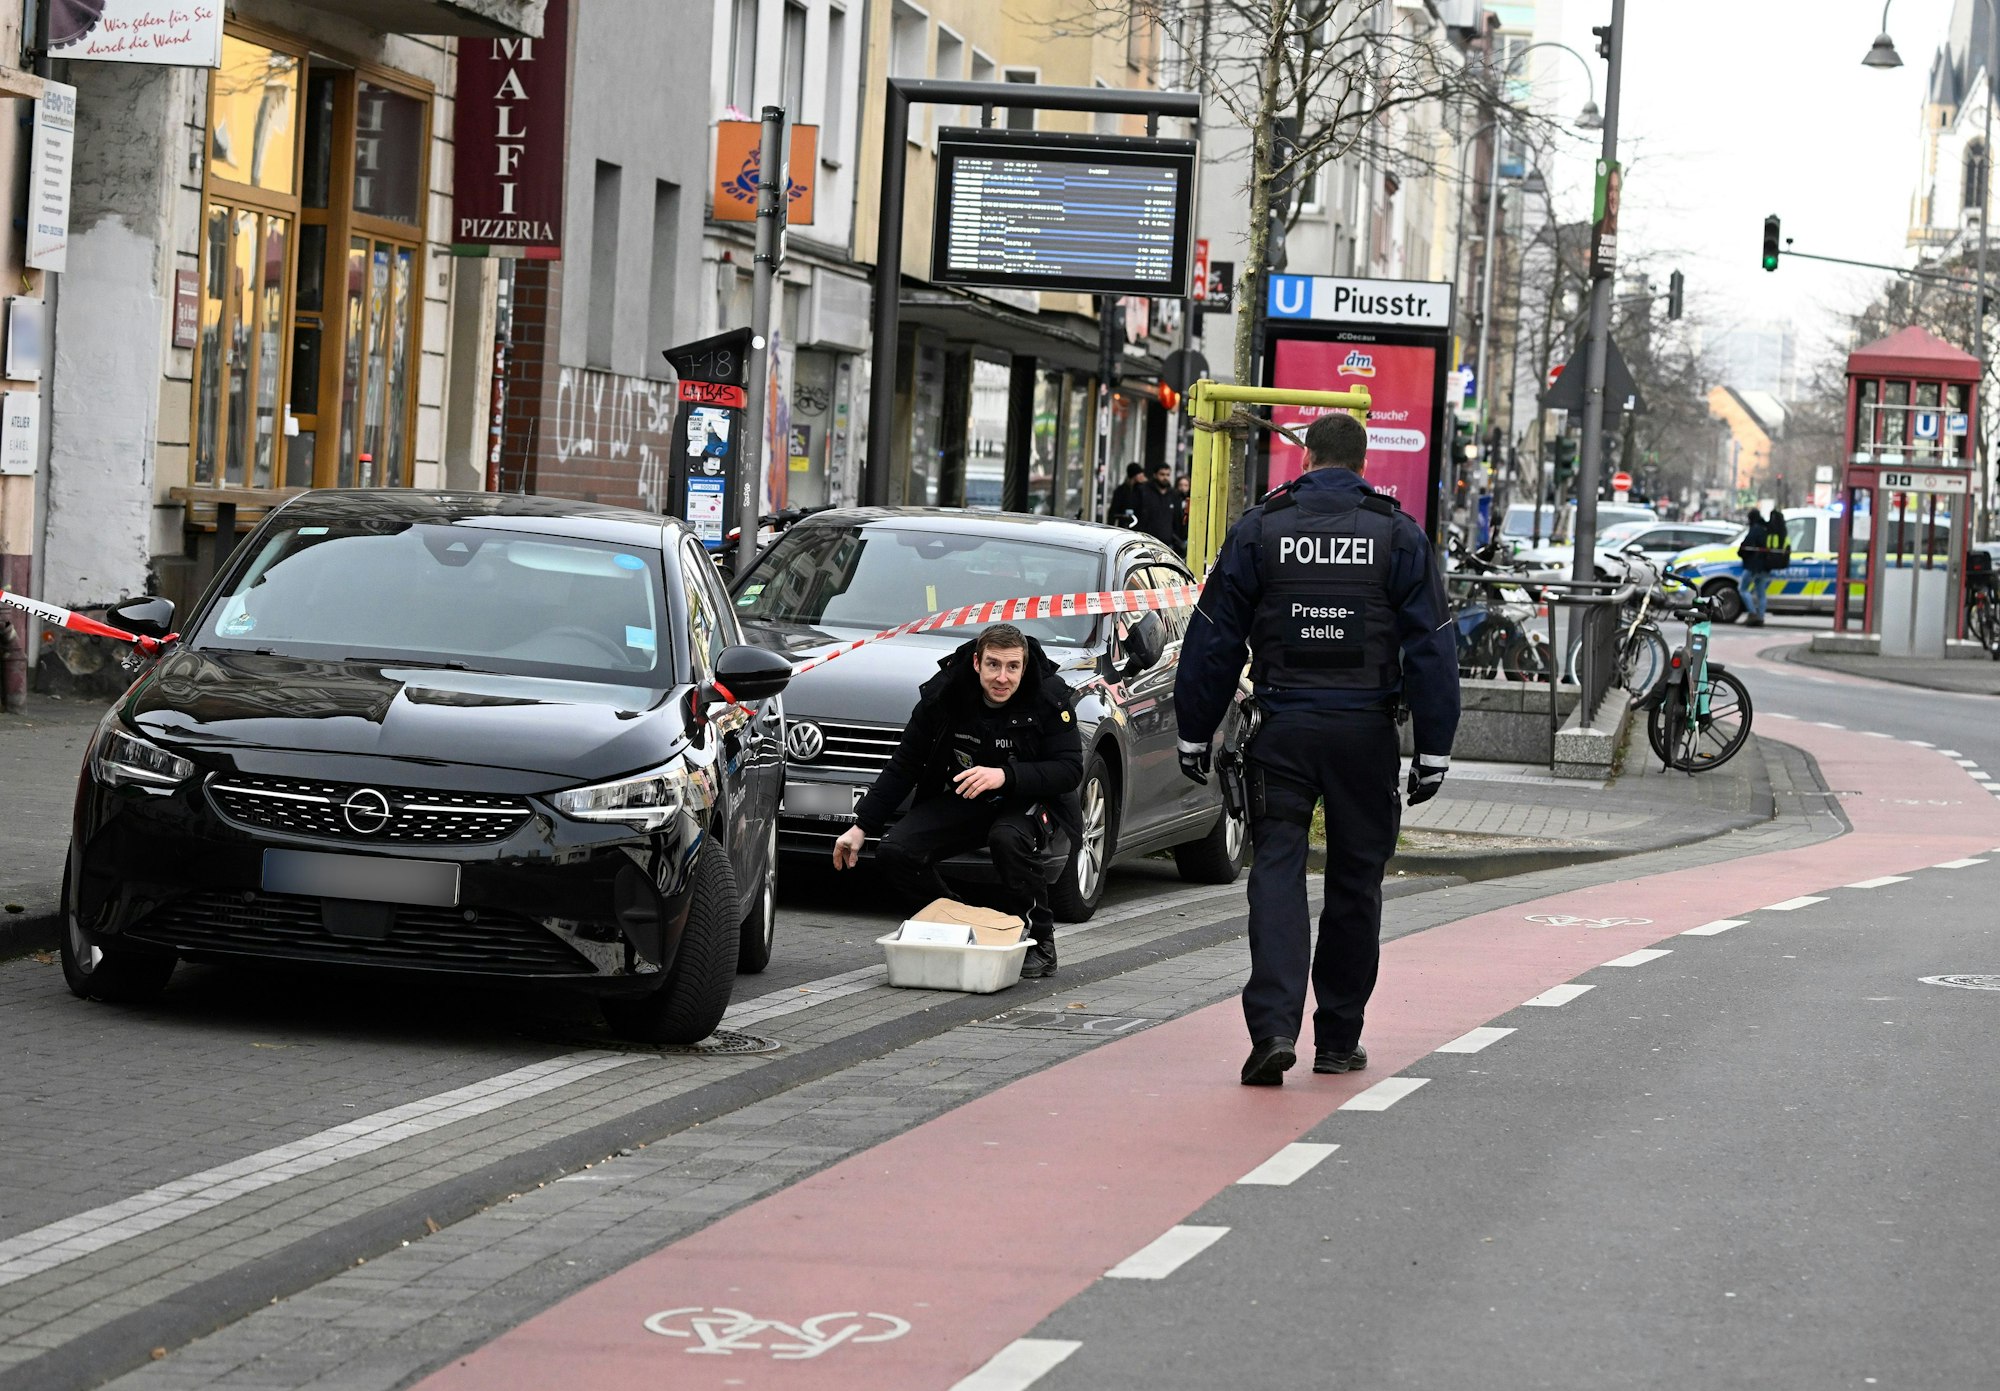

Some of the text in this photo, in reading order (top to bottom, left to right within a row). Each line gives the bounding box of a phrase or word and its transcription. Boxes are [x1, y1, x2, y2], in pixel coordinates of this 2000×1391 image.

[104, 6, 213, 33] Wir gehen für Sie
[86, 29, 192, 55] durch die Wand
[460, 218, 553, 241] PIZZERIA
[1275, 279, 1431, 318] U Piusstr.
[1336, 332, 1376, 342] JCDecaux
[1345, 350, 1373, 368] dm
[11, 415, 30, 428] ATELIER
[1916, 412, 1938, 436] U
[1369, 433, 1419, 446] Menschen
[1279, 537, 1374, 565] POLIZEI
[4, 598, 62, 624] POLIZEI
[1291, 603, 1355, 618] Presse-
[1301, 625, 1345, 639] stelle
